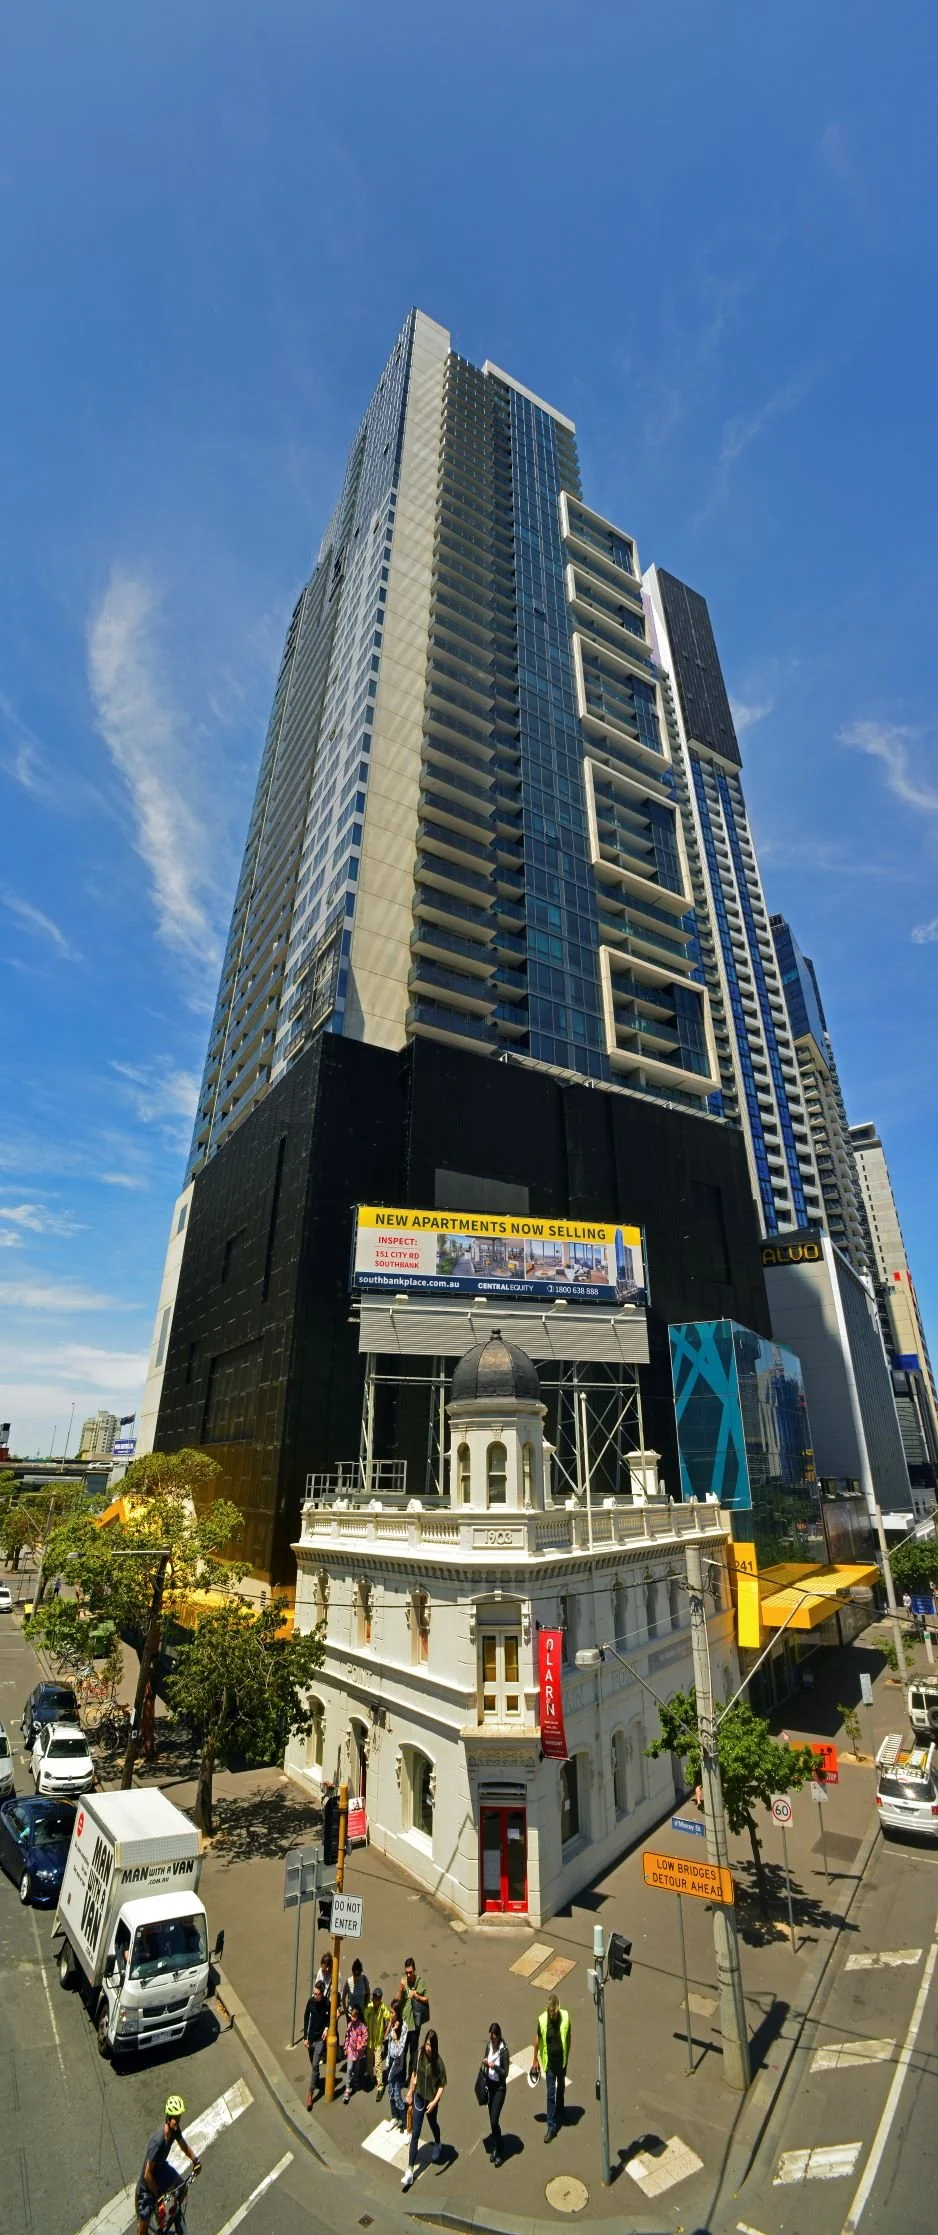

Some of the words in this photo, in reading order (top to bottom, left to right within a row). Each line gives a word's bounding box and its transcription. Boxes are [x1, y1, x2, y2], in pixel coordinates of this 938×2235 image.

[376, 1213, 408, 1226] NEW
[412, 1215, 507, 1233] APARTMENTS
[511, 1223, 544, 1235] NOW
[548, 1225, 606, 1240] SELLING
[378, 1236, 418, 1246] INSPECT:
[375, 1250, 388, 1258] 151
[391, 1251, 408, 1259] CITY
[409, 1252, 420, 1260] RD
[375, 1260, 420, 1269] SOUTHBANK
[358, 1276, 460, 1288] southbankplace.com.au
[555, 1286, 572, 1294] 1800
[573, 1287, 585, 1295] 638
[484, 1530, 513, 1544] 1903
[545, 1638, 556, 1716] OLARN
[775, 1804, 788, 1816] 60
[92, 1836, 114, 1887] MAN
[121, 1866, 149, 1884] MAN
[149, 1868, 165, 1877] WITH
[172, 1860, 195, 1876] VAN
[656, 1859, 674, 1871] LOW
[677, 1863, 717, 1881] BRIDGES
[652, 1872, 687, 1889] DETOUR
[691, 1881, 722, 1897] AHEAD
[334, 1900, 344, 1911] DO
[346, 1901, 361, 1913] NOT
[81, 1890, 102, 1954] VAN
[334, 1917, 358, 1931] ENTER
